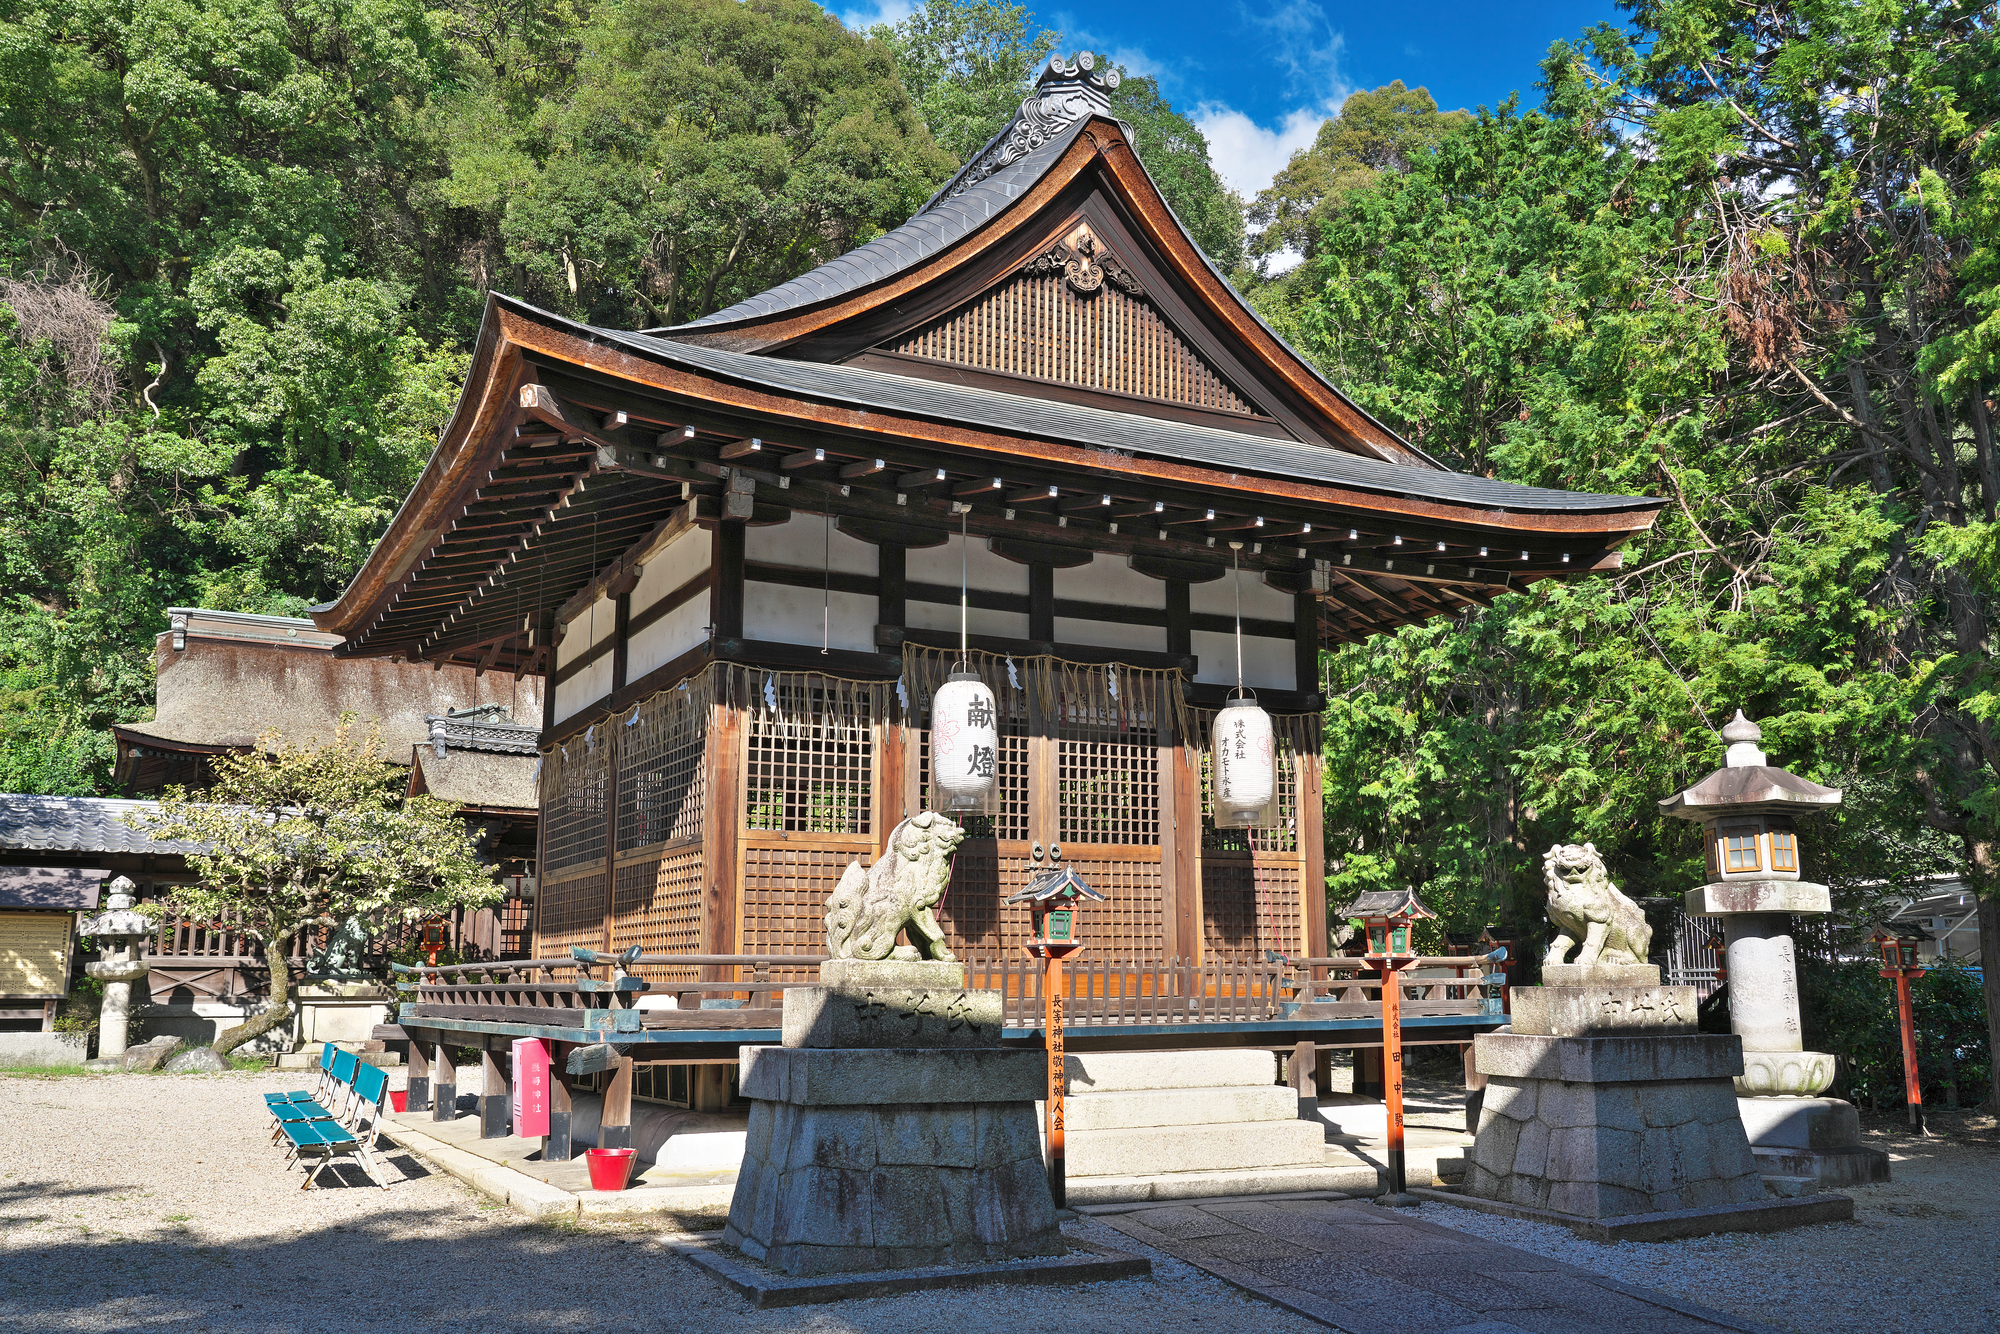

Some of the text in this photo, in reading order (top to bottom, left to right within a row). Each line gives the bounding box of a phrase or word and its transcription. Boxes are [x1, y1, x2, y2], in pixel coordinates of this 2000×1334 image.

[967, 693, 996, 778] 献燈
[1233, 718, 1247, 760] 株式会社
[1221, 736, 1231, 797] オカモト水産
[1391, 1003, 1399, 1038] 株式会社
[1052, 993, 1064, 1131] 長等神社敬神婦人会
